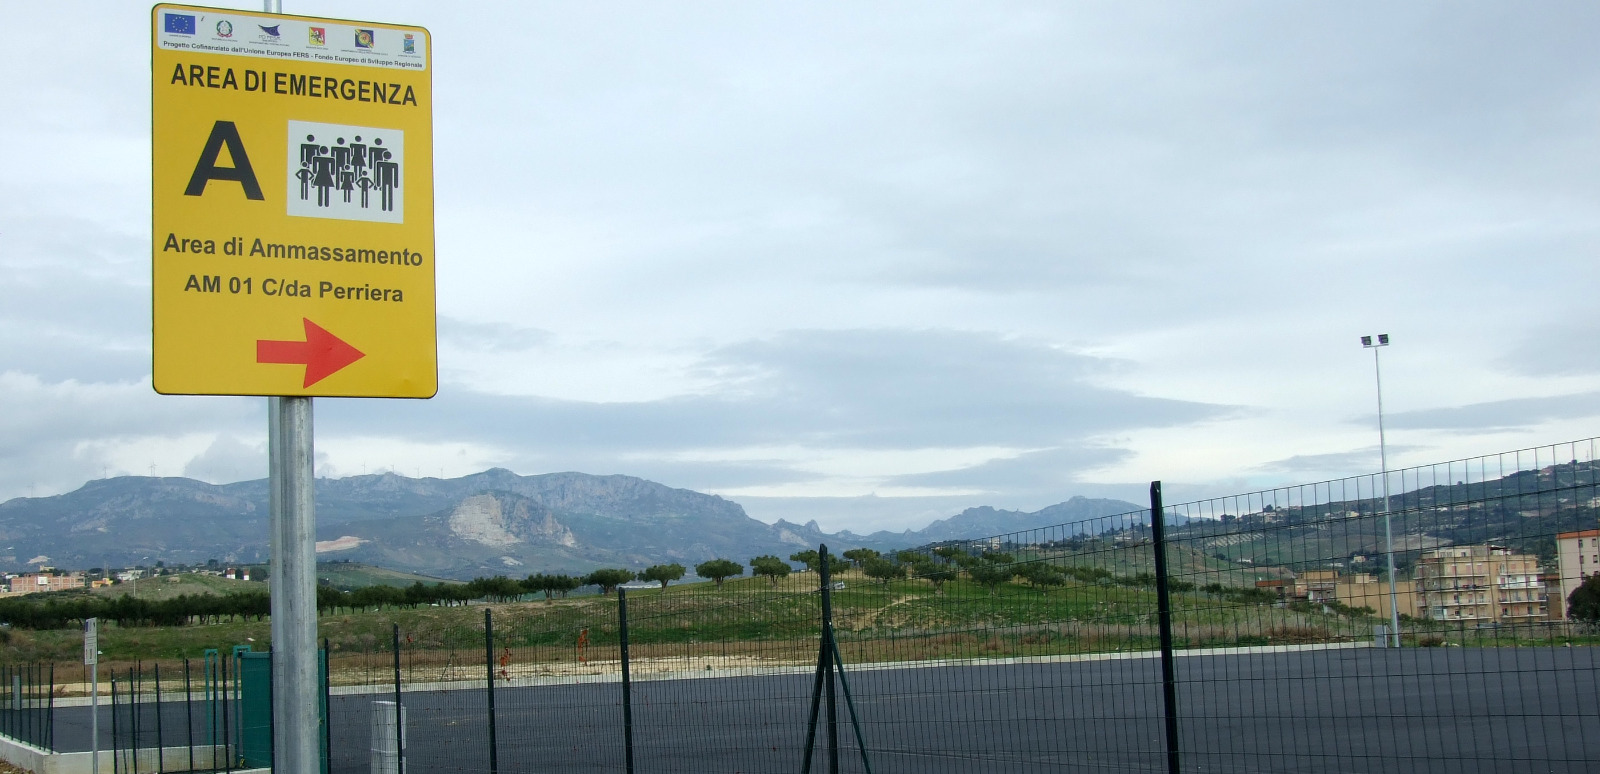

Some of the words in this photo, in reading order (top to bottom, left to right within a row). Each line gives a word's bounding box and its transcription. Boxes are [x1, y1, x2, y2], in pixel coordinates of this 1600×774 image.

[192, 43, 230, 51] Cofinanziato
[171, 63, 238, 90] AREA
[245, 70, 267, 92] DI
[274, 72, 418, 106] EMERGENZA
[184, 120, 265, 200] A
[163, 232, 216, 254] Area
[223, 237, 243, 256] di
[249, 238, 423, 266] Ammassamento
[184, 274, 221, 293] AM
[229, 276, 252, 294] 01
[262, 278, 311, 298] C/da
[319, 281, 403, 302] Perriera
